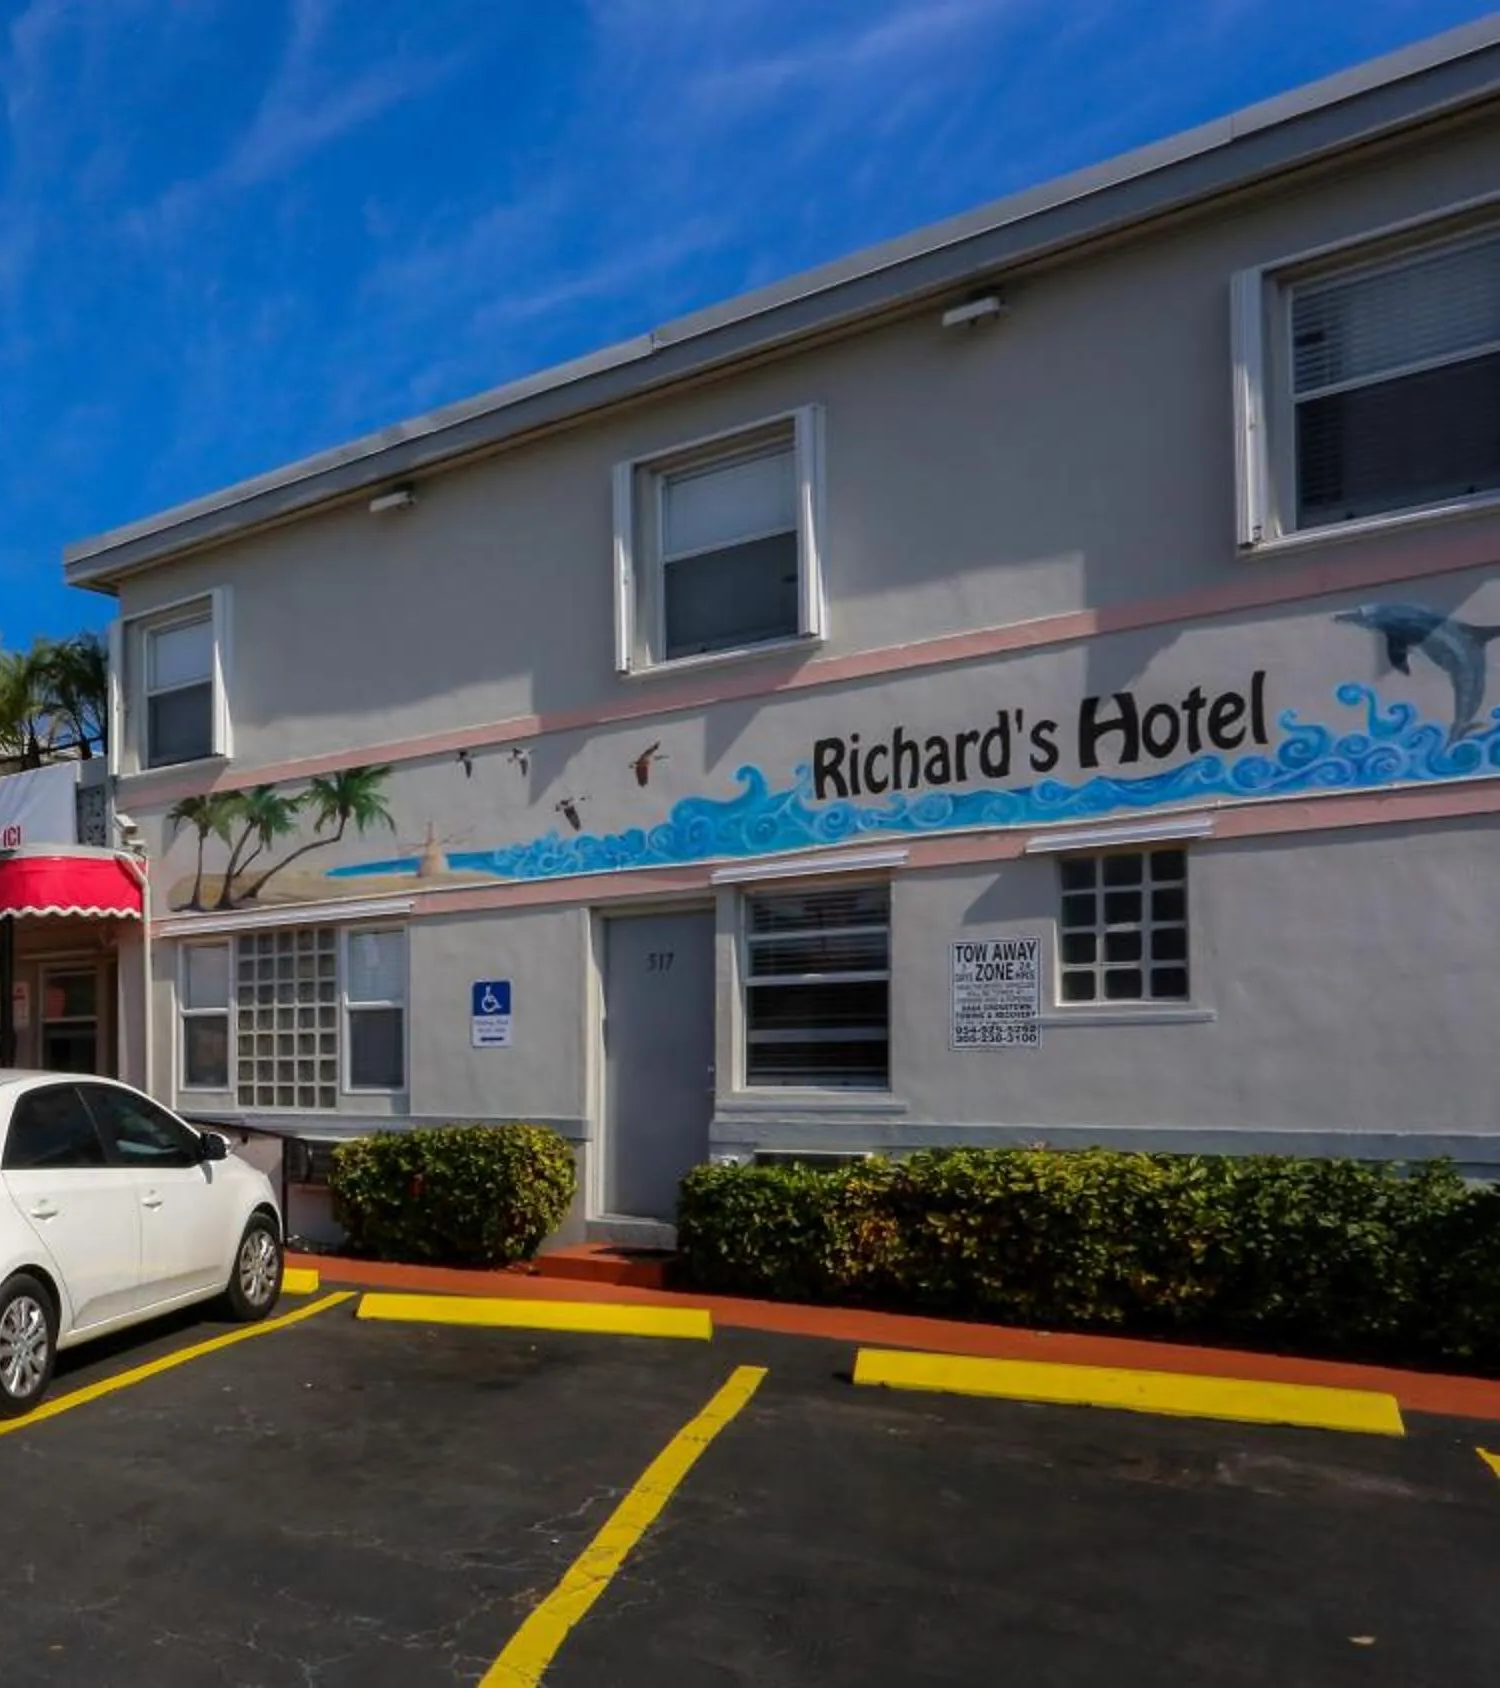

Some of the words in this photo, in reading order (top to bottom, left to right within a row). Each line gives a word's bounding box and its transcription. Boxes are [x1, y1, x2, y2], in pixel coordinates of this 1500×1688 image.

[813, 709, 1060, 800] Richard's
[1078, 670, 1269, 769] Hotel
[3, 825, 22, 848] ICI
[648, 952, 675, 971] 517
[955, 943, 988, 962] TOW
[993, 941, 1037, 961] AWAY
[975, 961, 1014, 981] ZONE
